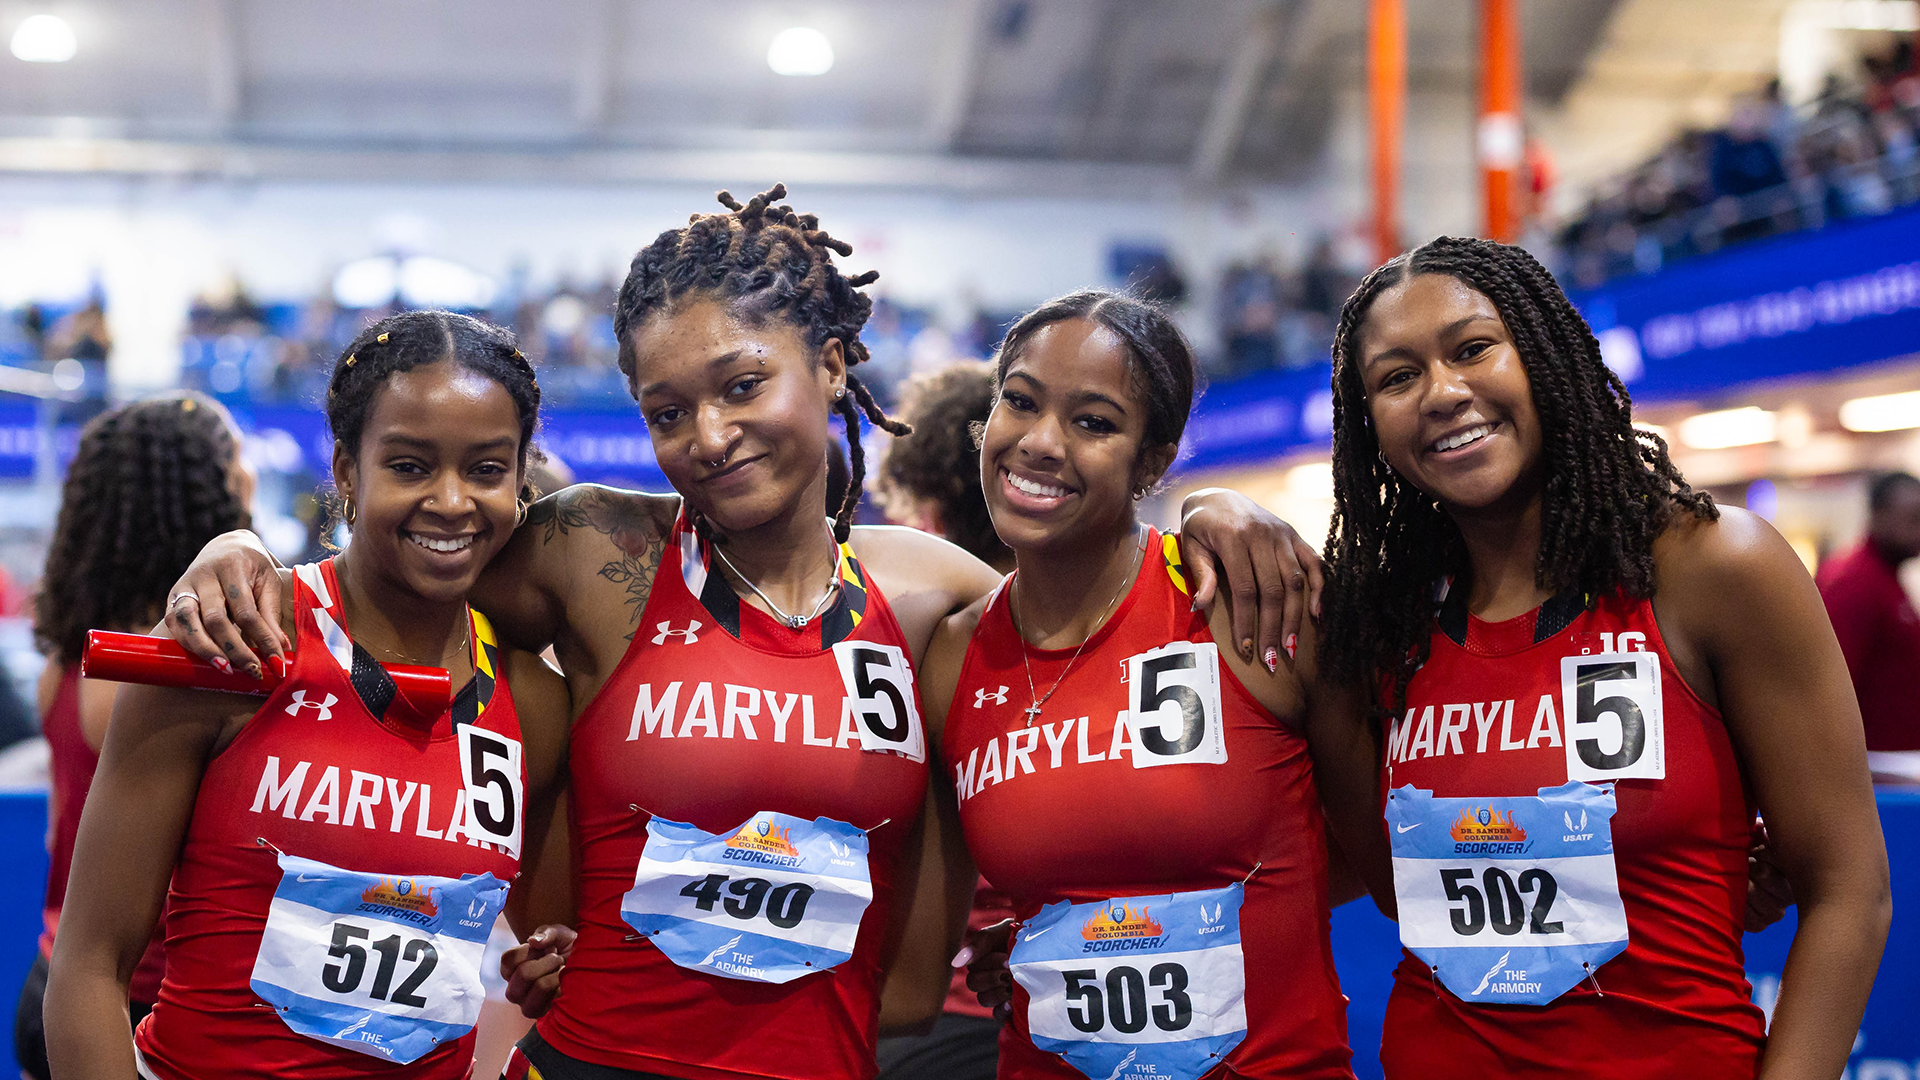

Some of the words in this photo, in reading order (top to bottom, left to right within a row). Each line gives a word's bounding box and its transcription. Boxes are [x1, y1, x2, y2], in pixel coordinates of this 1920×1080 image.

[851, 648, 910, 744] 5
[1139, 652, 1205, 756] 5
[625, 681, 910, 758] MARYLA
[1575, 661, 1646, 770] 5
[469, 733, 515, 838] 5
[249, 755, 514, 856] MARYLA
[753, 837, 786, 849] SANDER
[1563, 833, 1594, 842] USATF
[738, 841, 783, 854] COLUMBIA
[830, 858, 856, 867] USATF
[374, 898, 419, 910] COLUMBIA
[390, 896, 426, 906] SANDER
[679, 873, 816, 930] 490
[1439, 866, 1565, 936] 502
[459, 919, 483, 928] USATF
[1198, 924, 1225, 935] USATF
[1096, 931, 1145, 939] COLUMBIA
[732, 951, 754, 965] THE
[321, 922, 439, 1008] 512
[715, 961, 765, 978] ARMORY
[1504, 970, 1527, 981] THE
[1490, 982, 1542, 994] ARMORY
[1061, 962, 1193, 1034] 503
[361, 1031, 383, 1044] THE
[1134, 1064, 1157, 1074] THE
